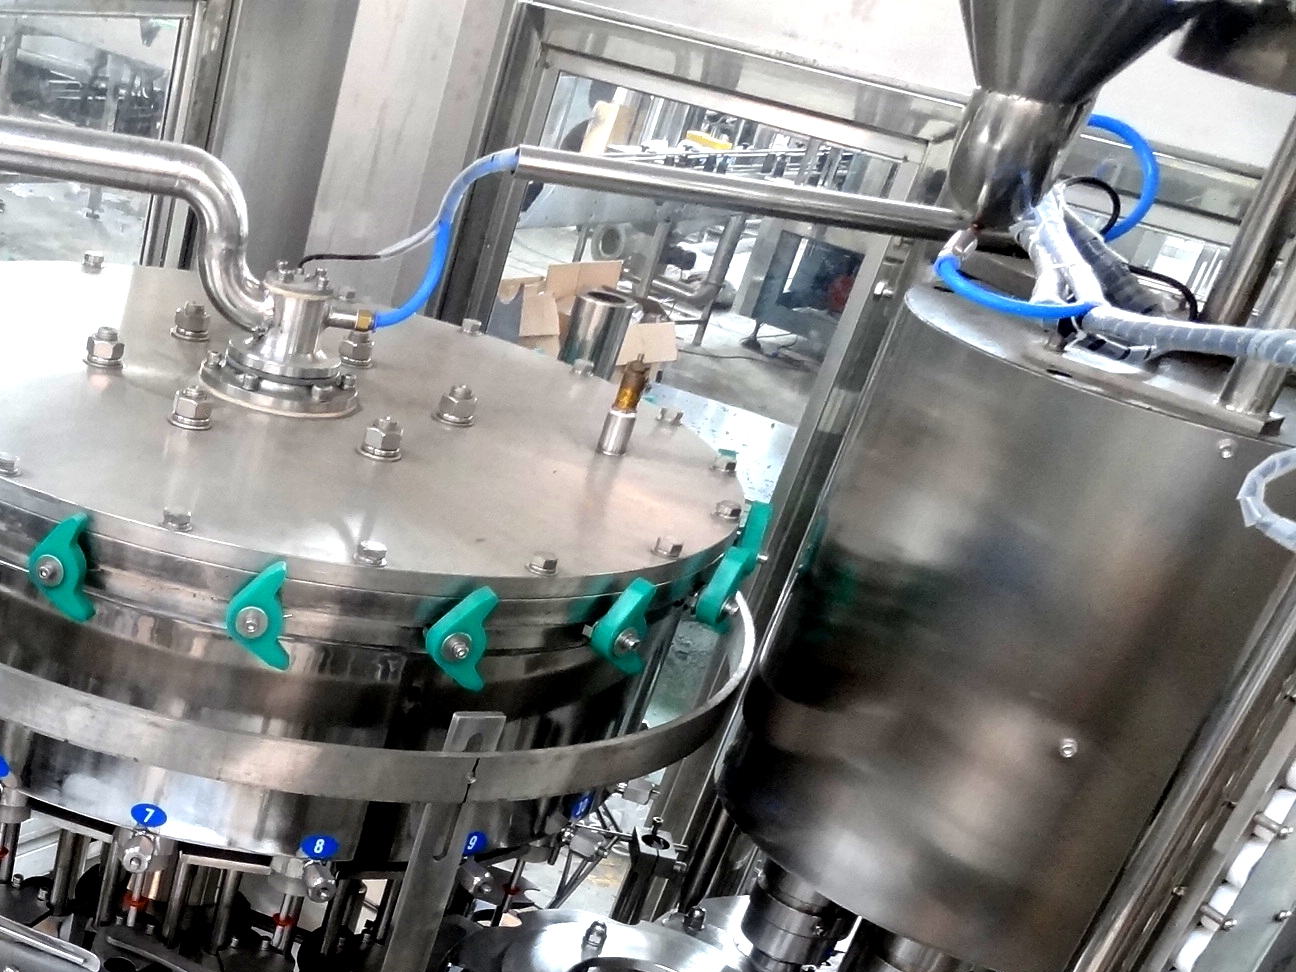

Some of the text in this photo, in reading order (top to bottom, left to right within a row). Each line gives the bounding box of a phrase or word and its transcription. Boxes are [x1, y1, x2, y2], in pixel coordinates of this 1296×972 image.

[144, 808, 155, 823] 7
[313, 839, 325, 854] 8
[467, 835, 478, 850] 9
